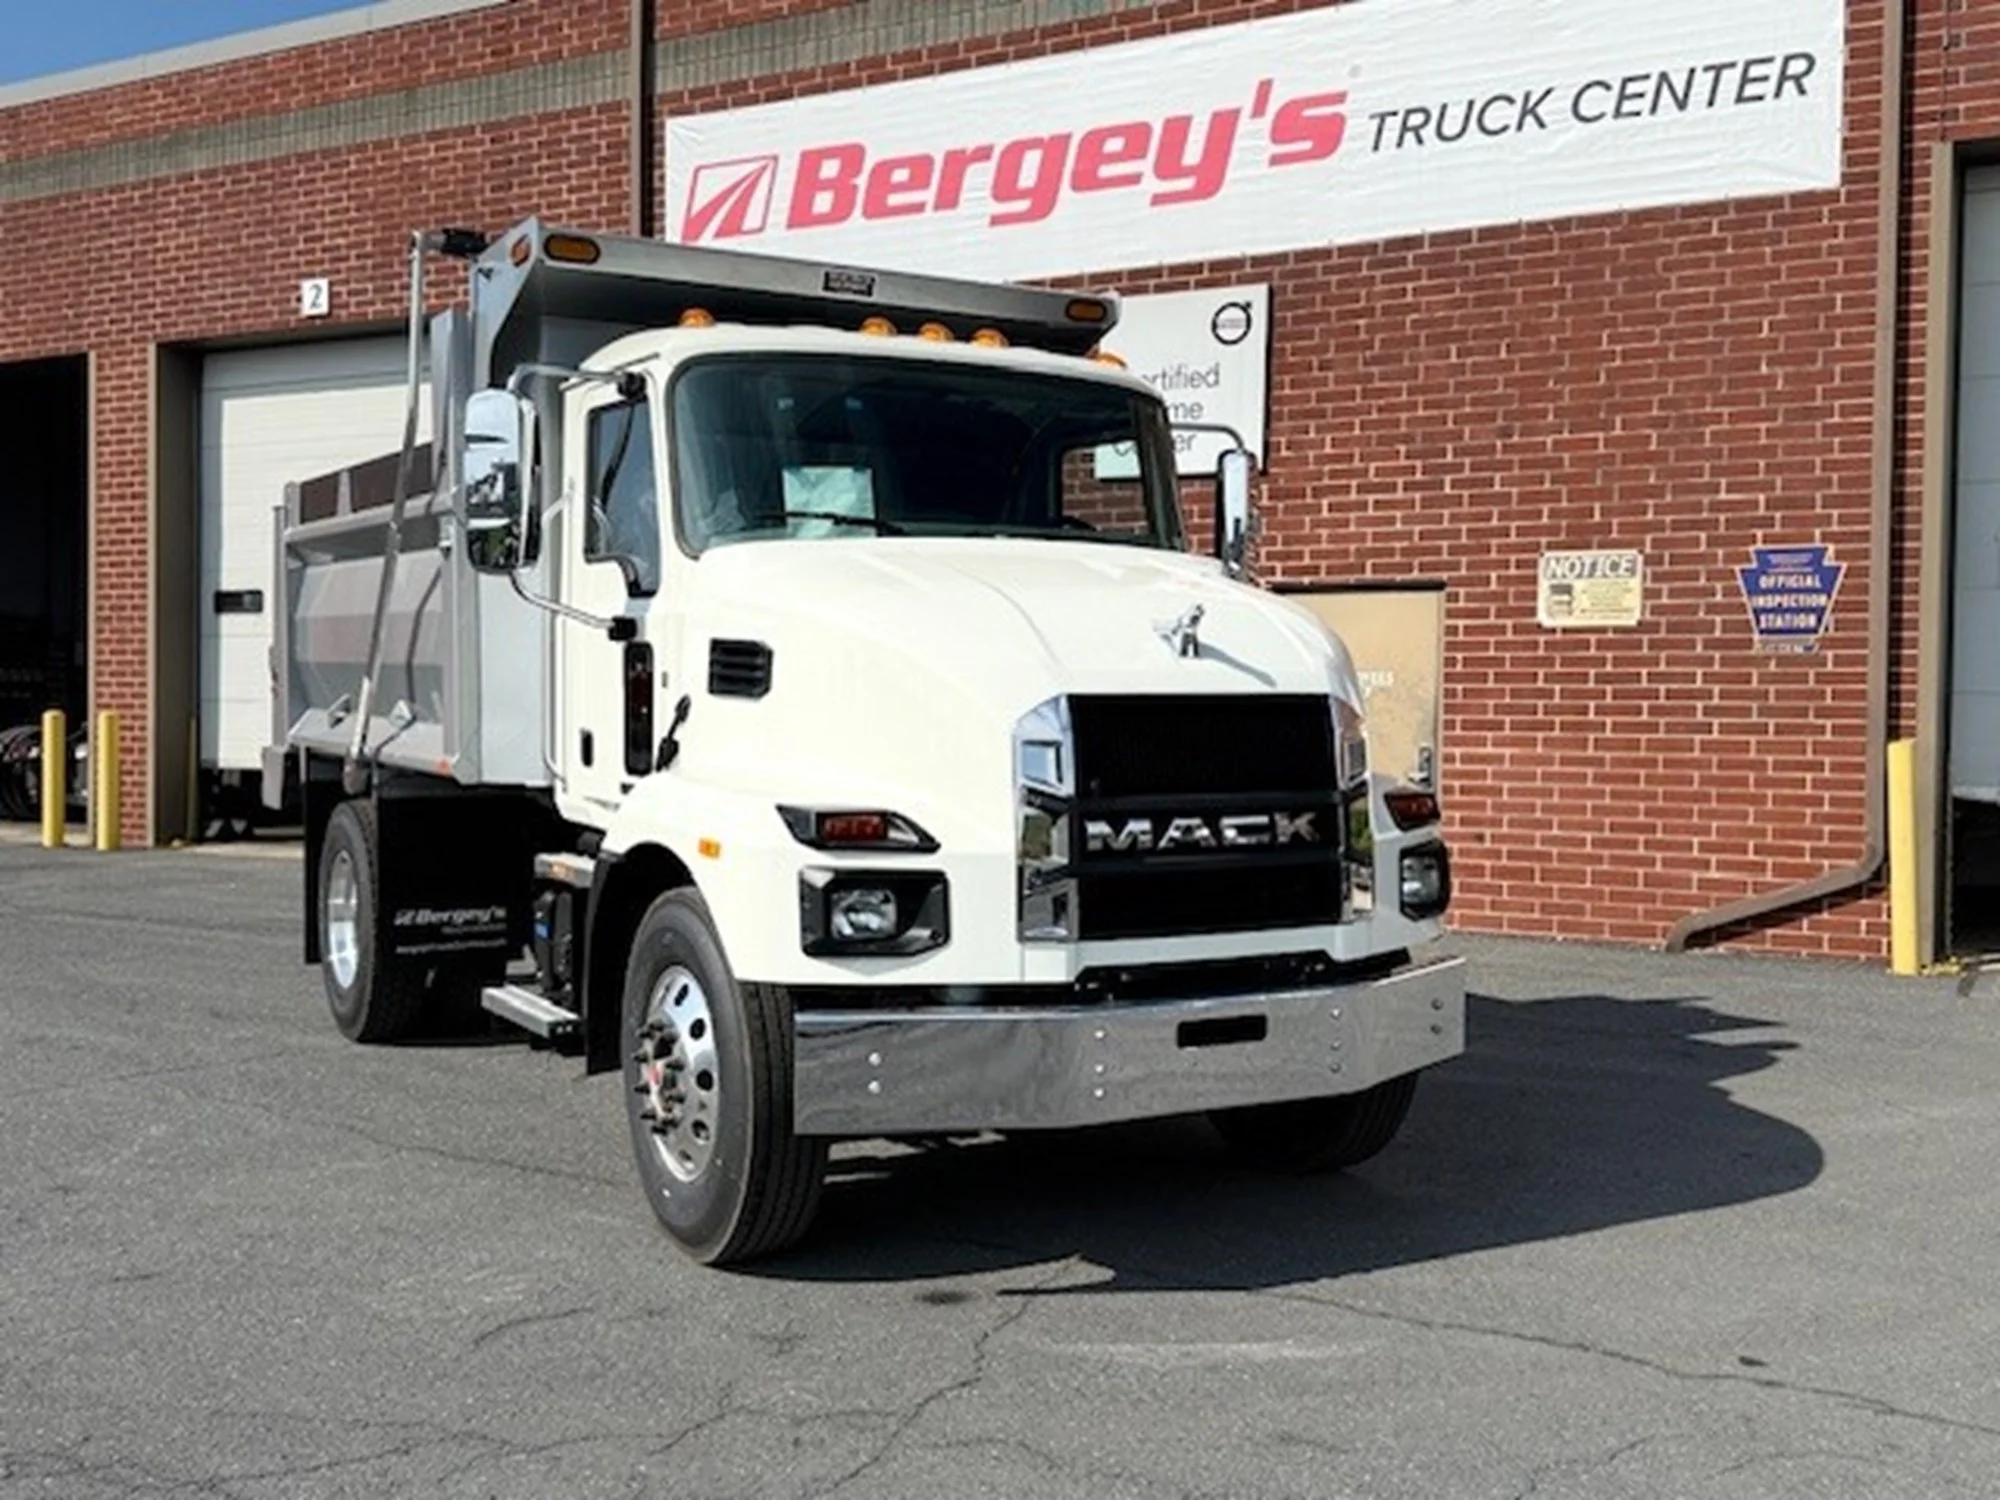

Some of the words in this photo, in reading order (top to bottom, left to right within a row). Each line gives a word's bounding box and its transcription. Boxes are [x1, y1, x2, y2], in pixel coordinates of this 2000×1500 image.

[786, 79, 1347, 229] Bergey's
[1368, 87, 1555, 152] TRUCK
[1571, 51, 1817, 125] CENTER
[309, 284, 323, 308] 2
[1546, 555, 1635, 579] NOTICE
[1759, 574, 1822, 589] OFFICIAL
[1751, 593, 1828, 609] INSPECTION
[1759, 613, 1818, 629] STATION
[1085, 812, 1319, 851] MACK
